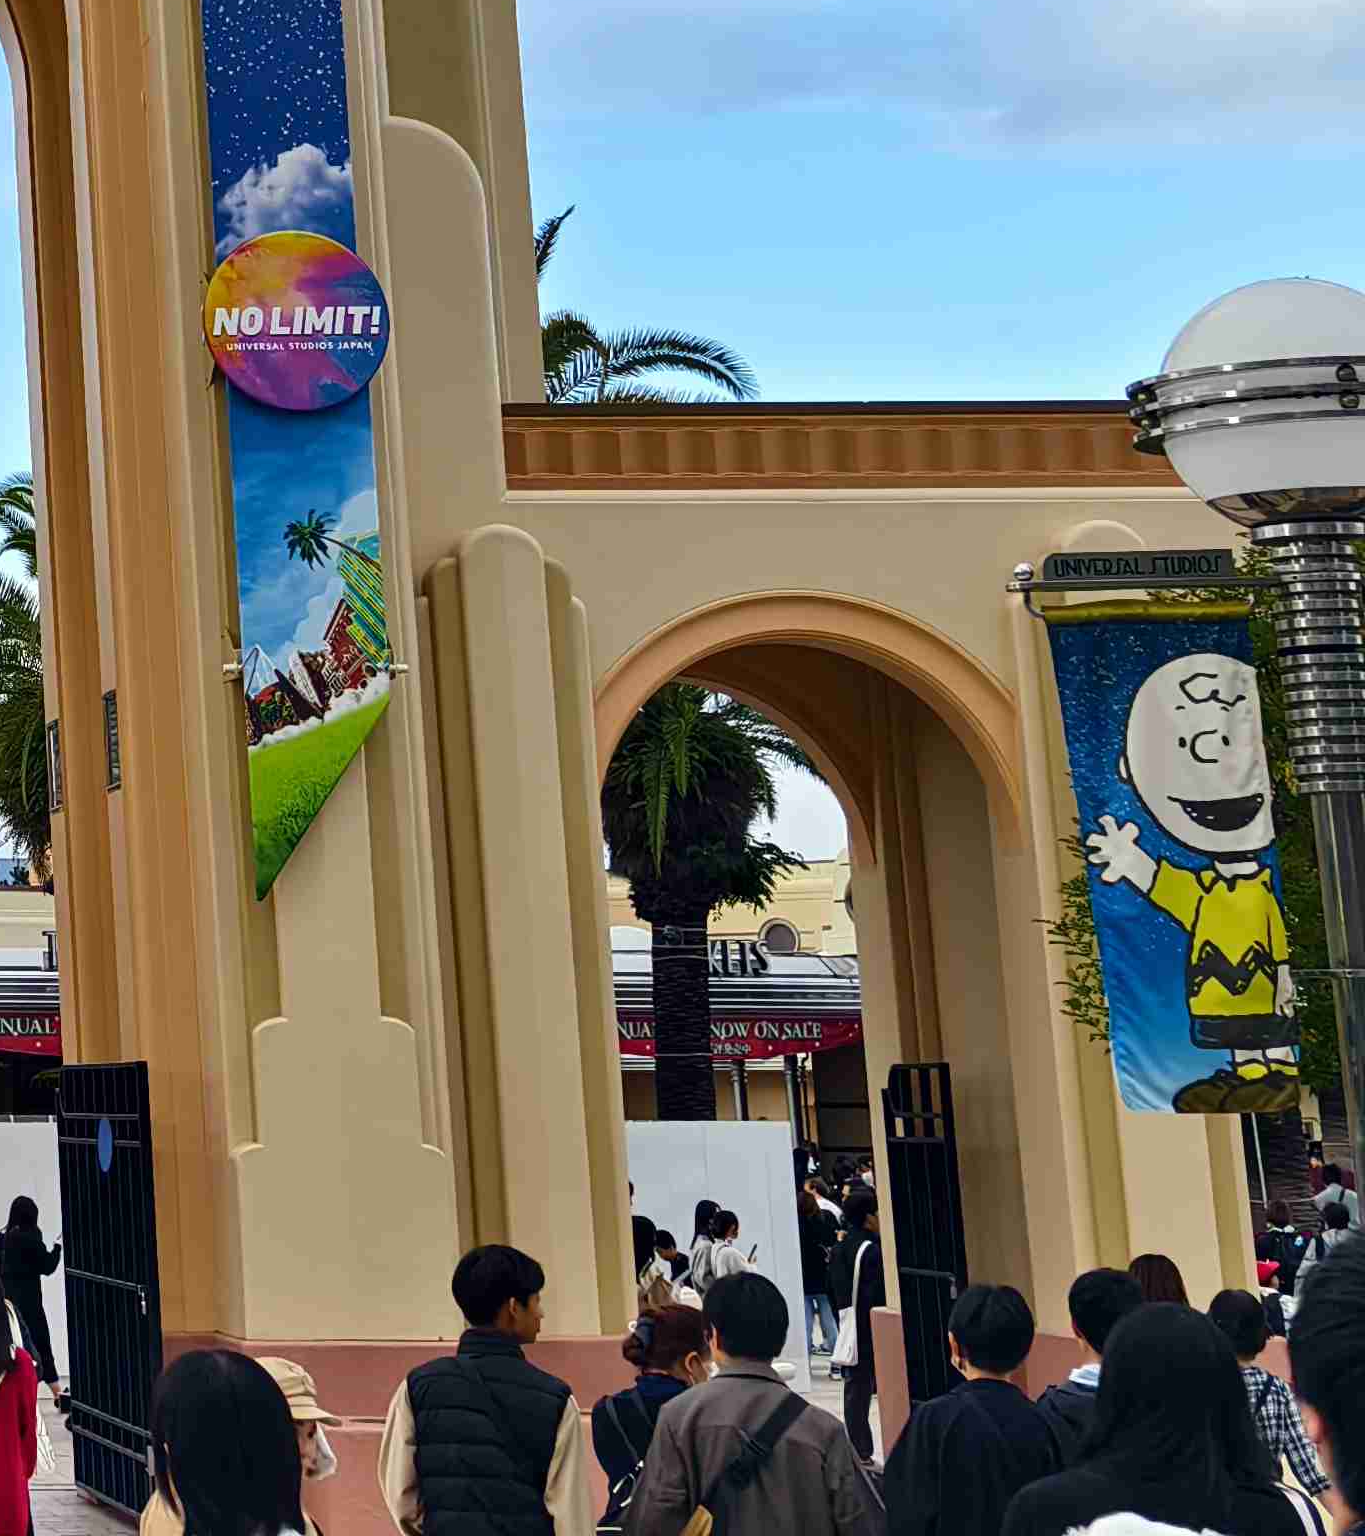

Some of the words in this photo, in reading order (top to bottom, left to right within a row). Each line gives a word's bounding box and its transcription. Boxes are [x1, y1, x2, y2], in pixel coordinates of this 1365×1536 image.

[212, 307, 264, 336] NO
[269, 305, 382, 336] LIMIT!
[226, 341, 285, 351] UNIVERSAL
[288, 341, 334, 351] STUDIOS
[338, 340, 372, 350] JAPAN
[1053, 557, 1145, 577] UNIVERSAL
[1148, 555, 1222, 575] STUDIOS
[708, 941, 774, 976] KETS
[618, 1021, 656, 1039] NUA
[709, 1022, 749, 1038] NOW
[754, 1022, 780, 1039] ON
[782, 1022, 822, 1039] SALE
